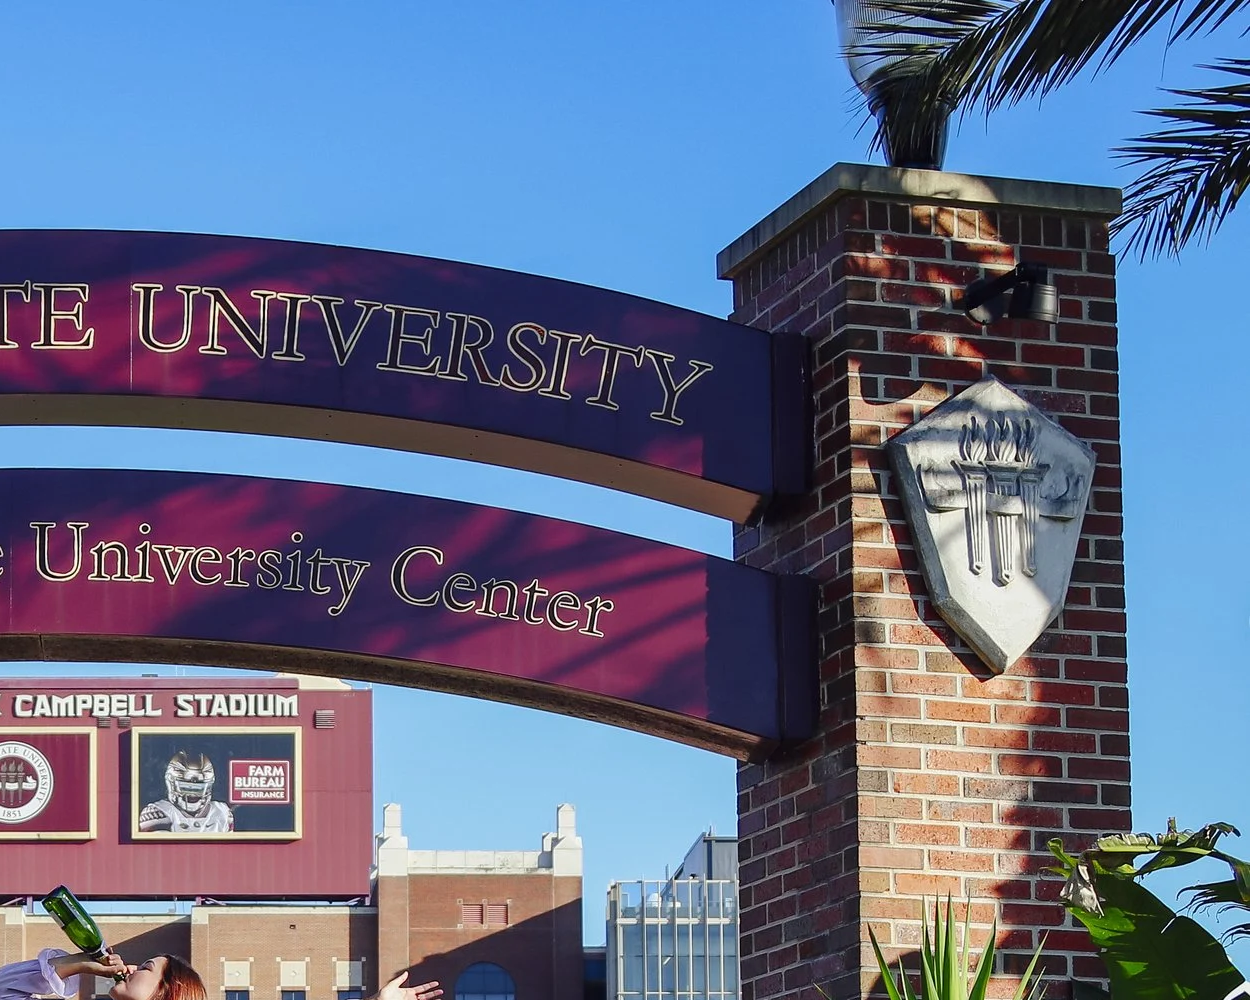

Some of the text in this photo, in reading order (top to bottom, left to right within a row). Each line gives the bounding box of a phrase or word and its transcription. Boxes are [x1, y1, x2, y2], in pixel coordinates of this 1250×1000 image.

[132, 282, 714, 427] UNIVERSITY
[29, 521, 371, 616] University
[390, 545, 616, 639] Center
[14, 693, 163, 719] CAMPBELL
[176, 693, 300, 718] STADIUM
[22, 749, 49, 804] UNIVERSITY
[249, 765, 284, 776] FARM
[235, 777, 284, 787] BUREAU
[241, 791, 284, 799] INSURANCE
[2, 810, 22, 818] 1851
